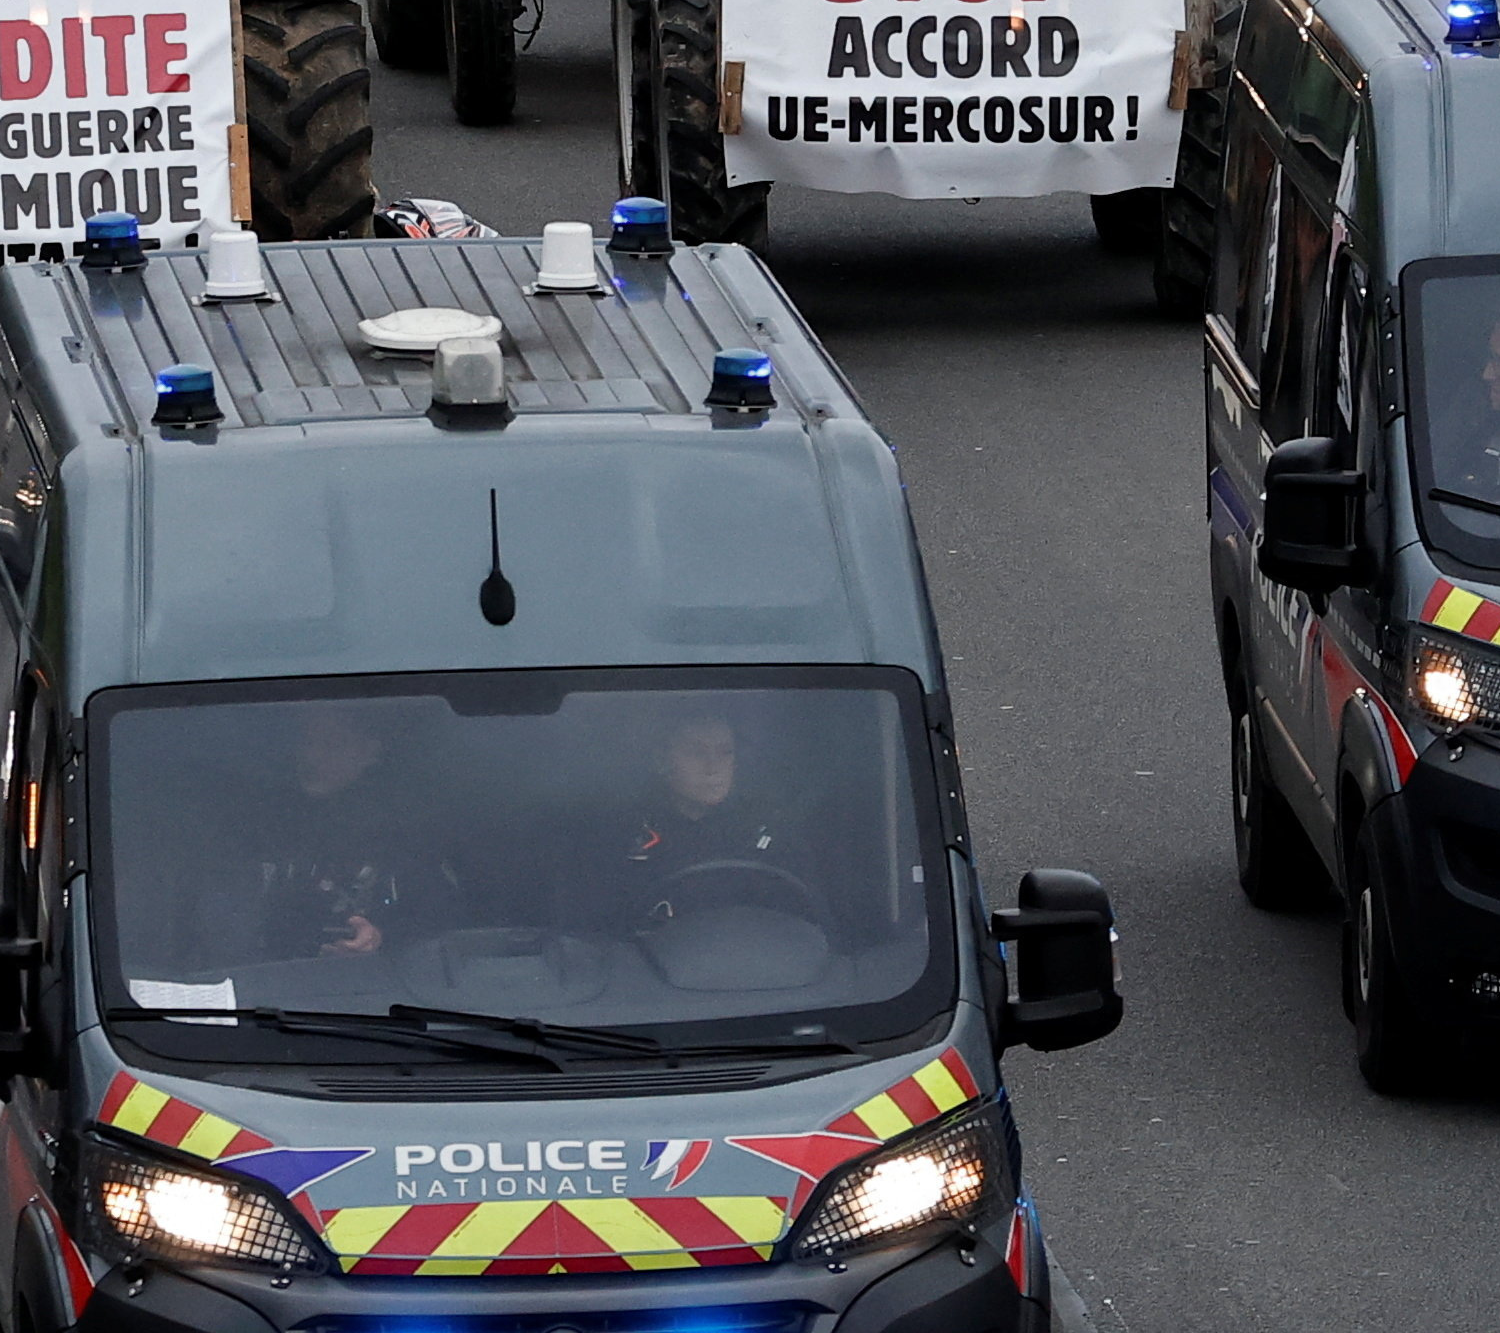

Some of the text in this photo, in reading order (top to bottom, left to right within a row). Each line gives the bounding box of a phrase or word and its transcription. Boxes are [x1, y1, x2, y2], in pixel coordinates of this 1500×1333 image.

[827, 15, 1080, 79] ACCORD
[767, 95, 1139, 144] UE-MERCOSUR !
[395, 1139, 628, 1176] POLICE
[396, 1175, 629, 1200] NATIONALE
